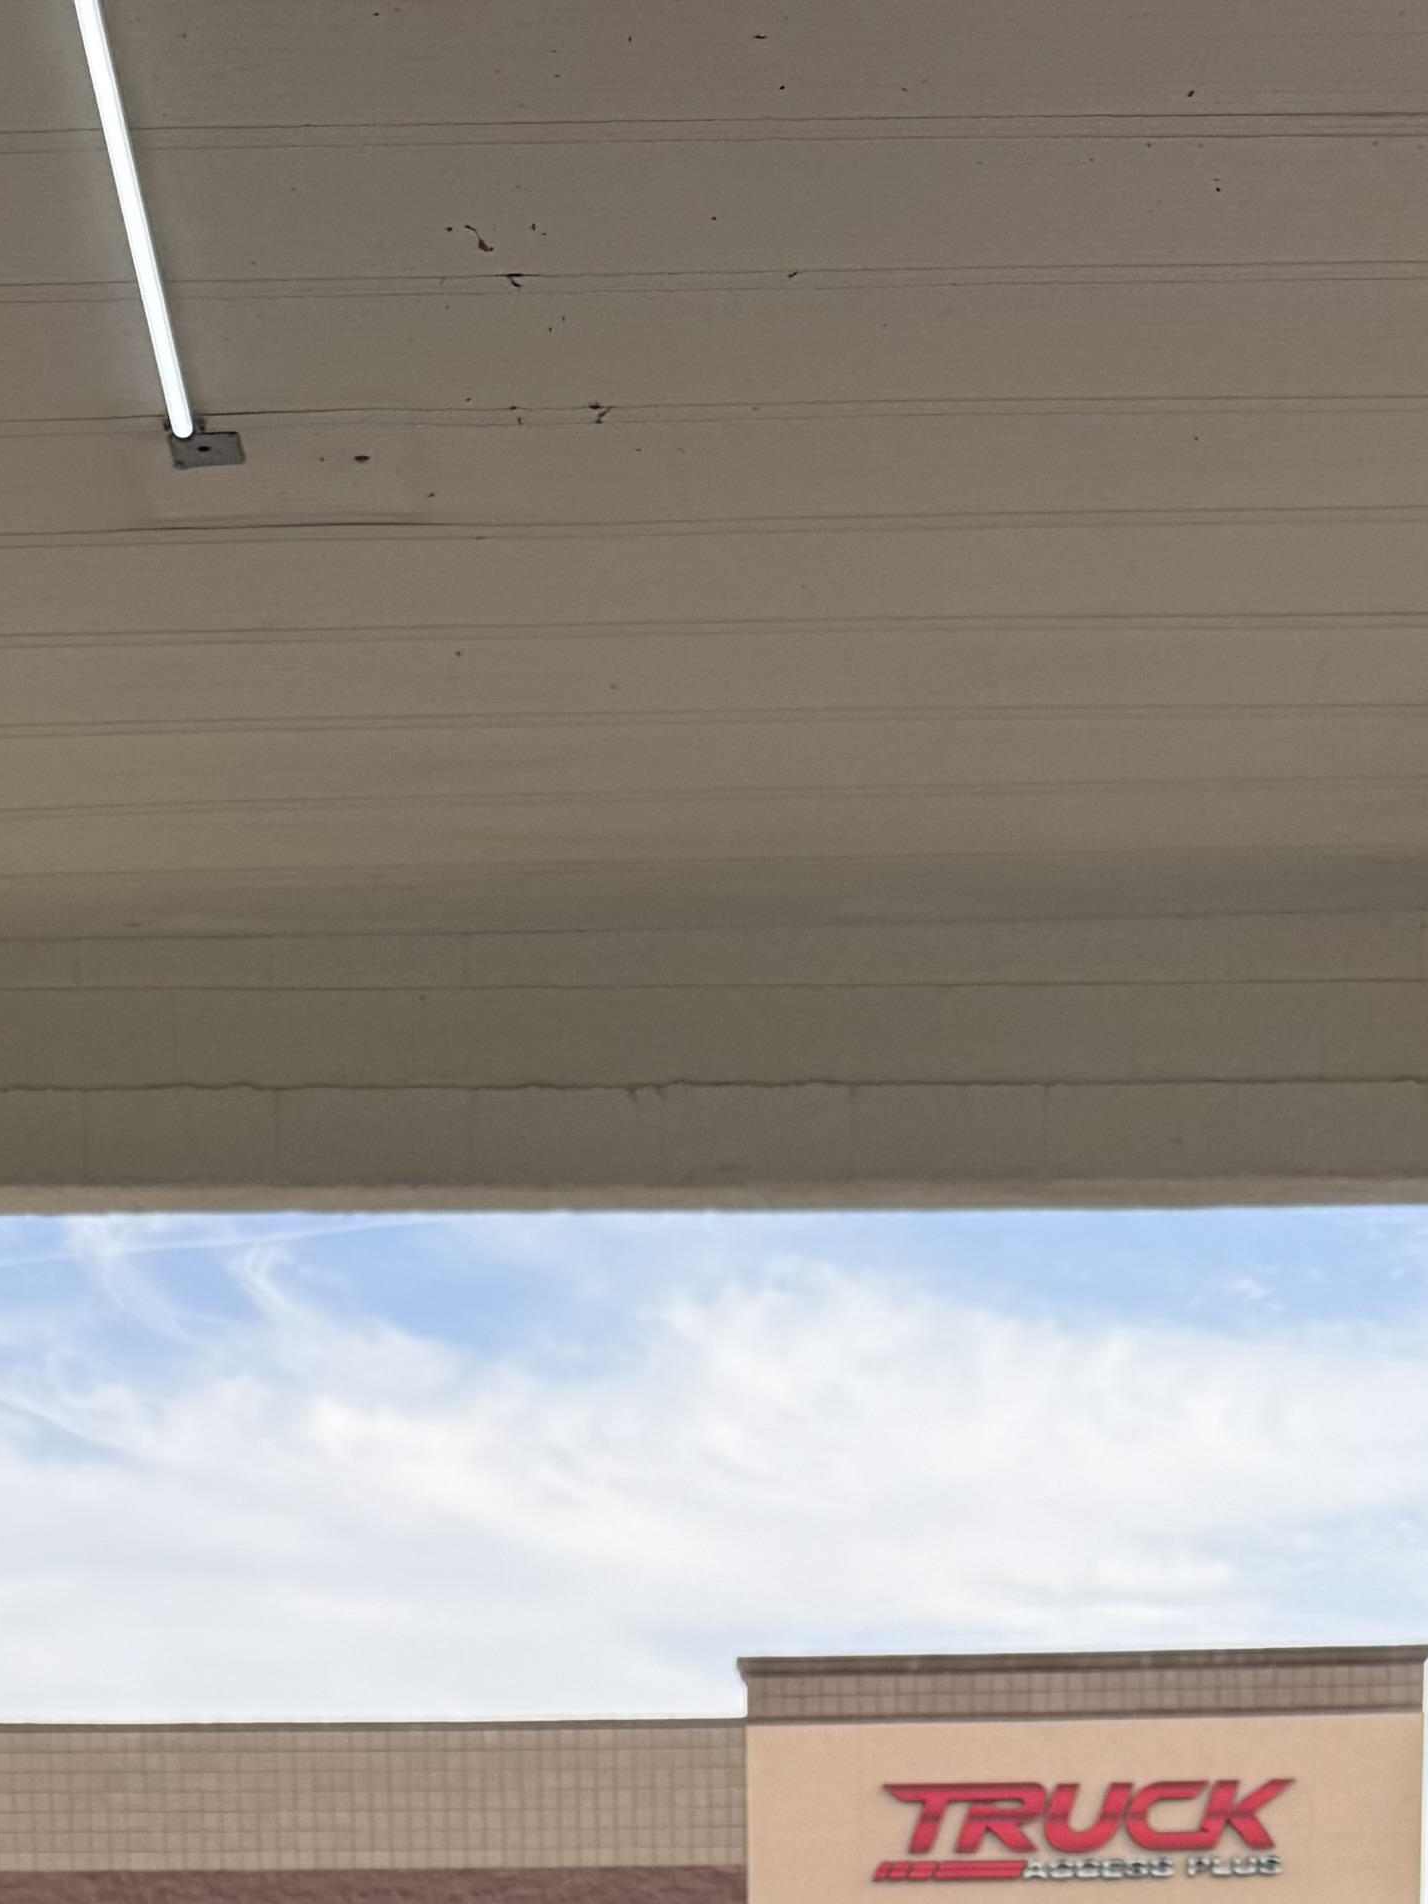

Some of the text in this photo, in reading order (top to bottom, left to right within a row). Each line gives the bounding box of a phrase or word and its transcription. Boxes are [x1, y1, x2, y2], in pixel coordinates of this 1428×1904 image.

[882, 1777, 1296, 1854] TRUCK
[1023, 1854, 1283, 1879] ACCESS PLUS
